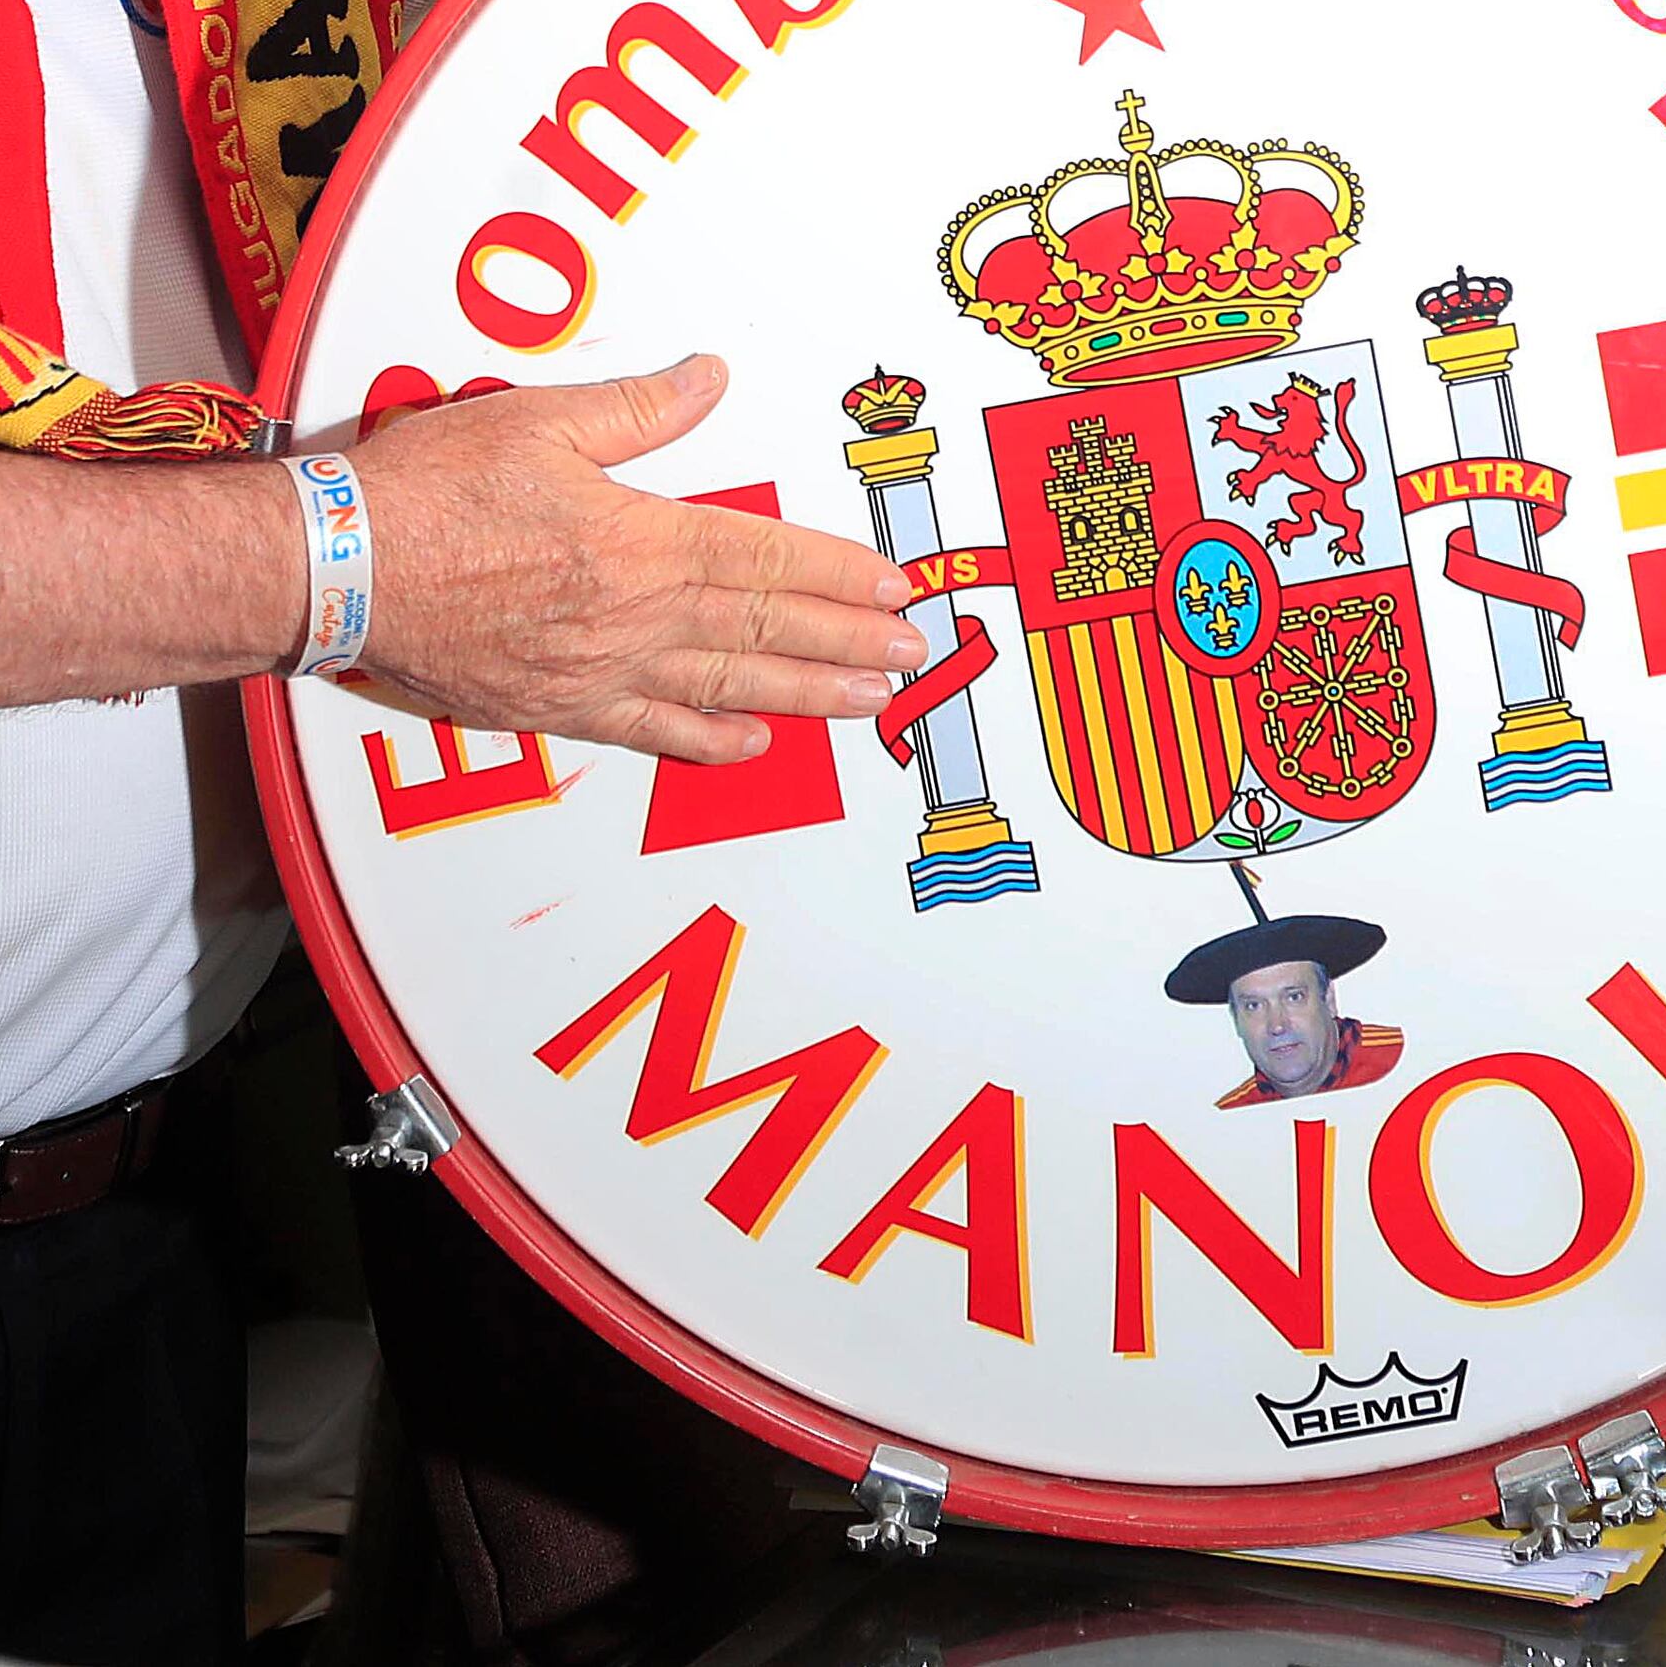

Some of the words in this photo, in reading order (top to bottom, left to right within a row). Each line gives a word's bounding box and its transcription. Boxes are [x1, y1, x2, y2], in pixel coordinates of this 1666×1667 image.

[1408, 462, 1556, 504] VLTRA
[321, 486, 365, 563] PNG
[1292, 1387, 1442, 1437] REMO
